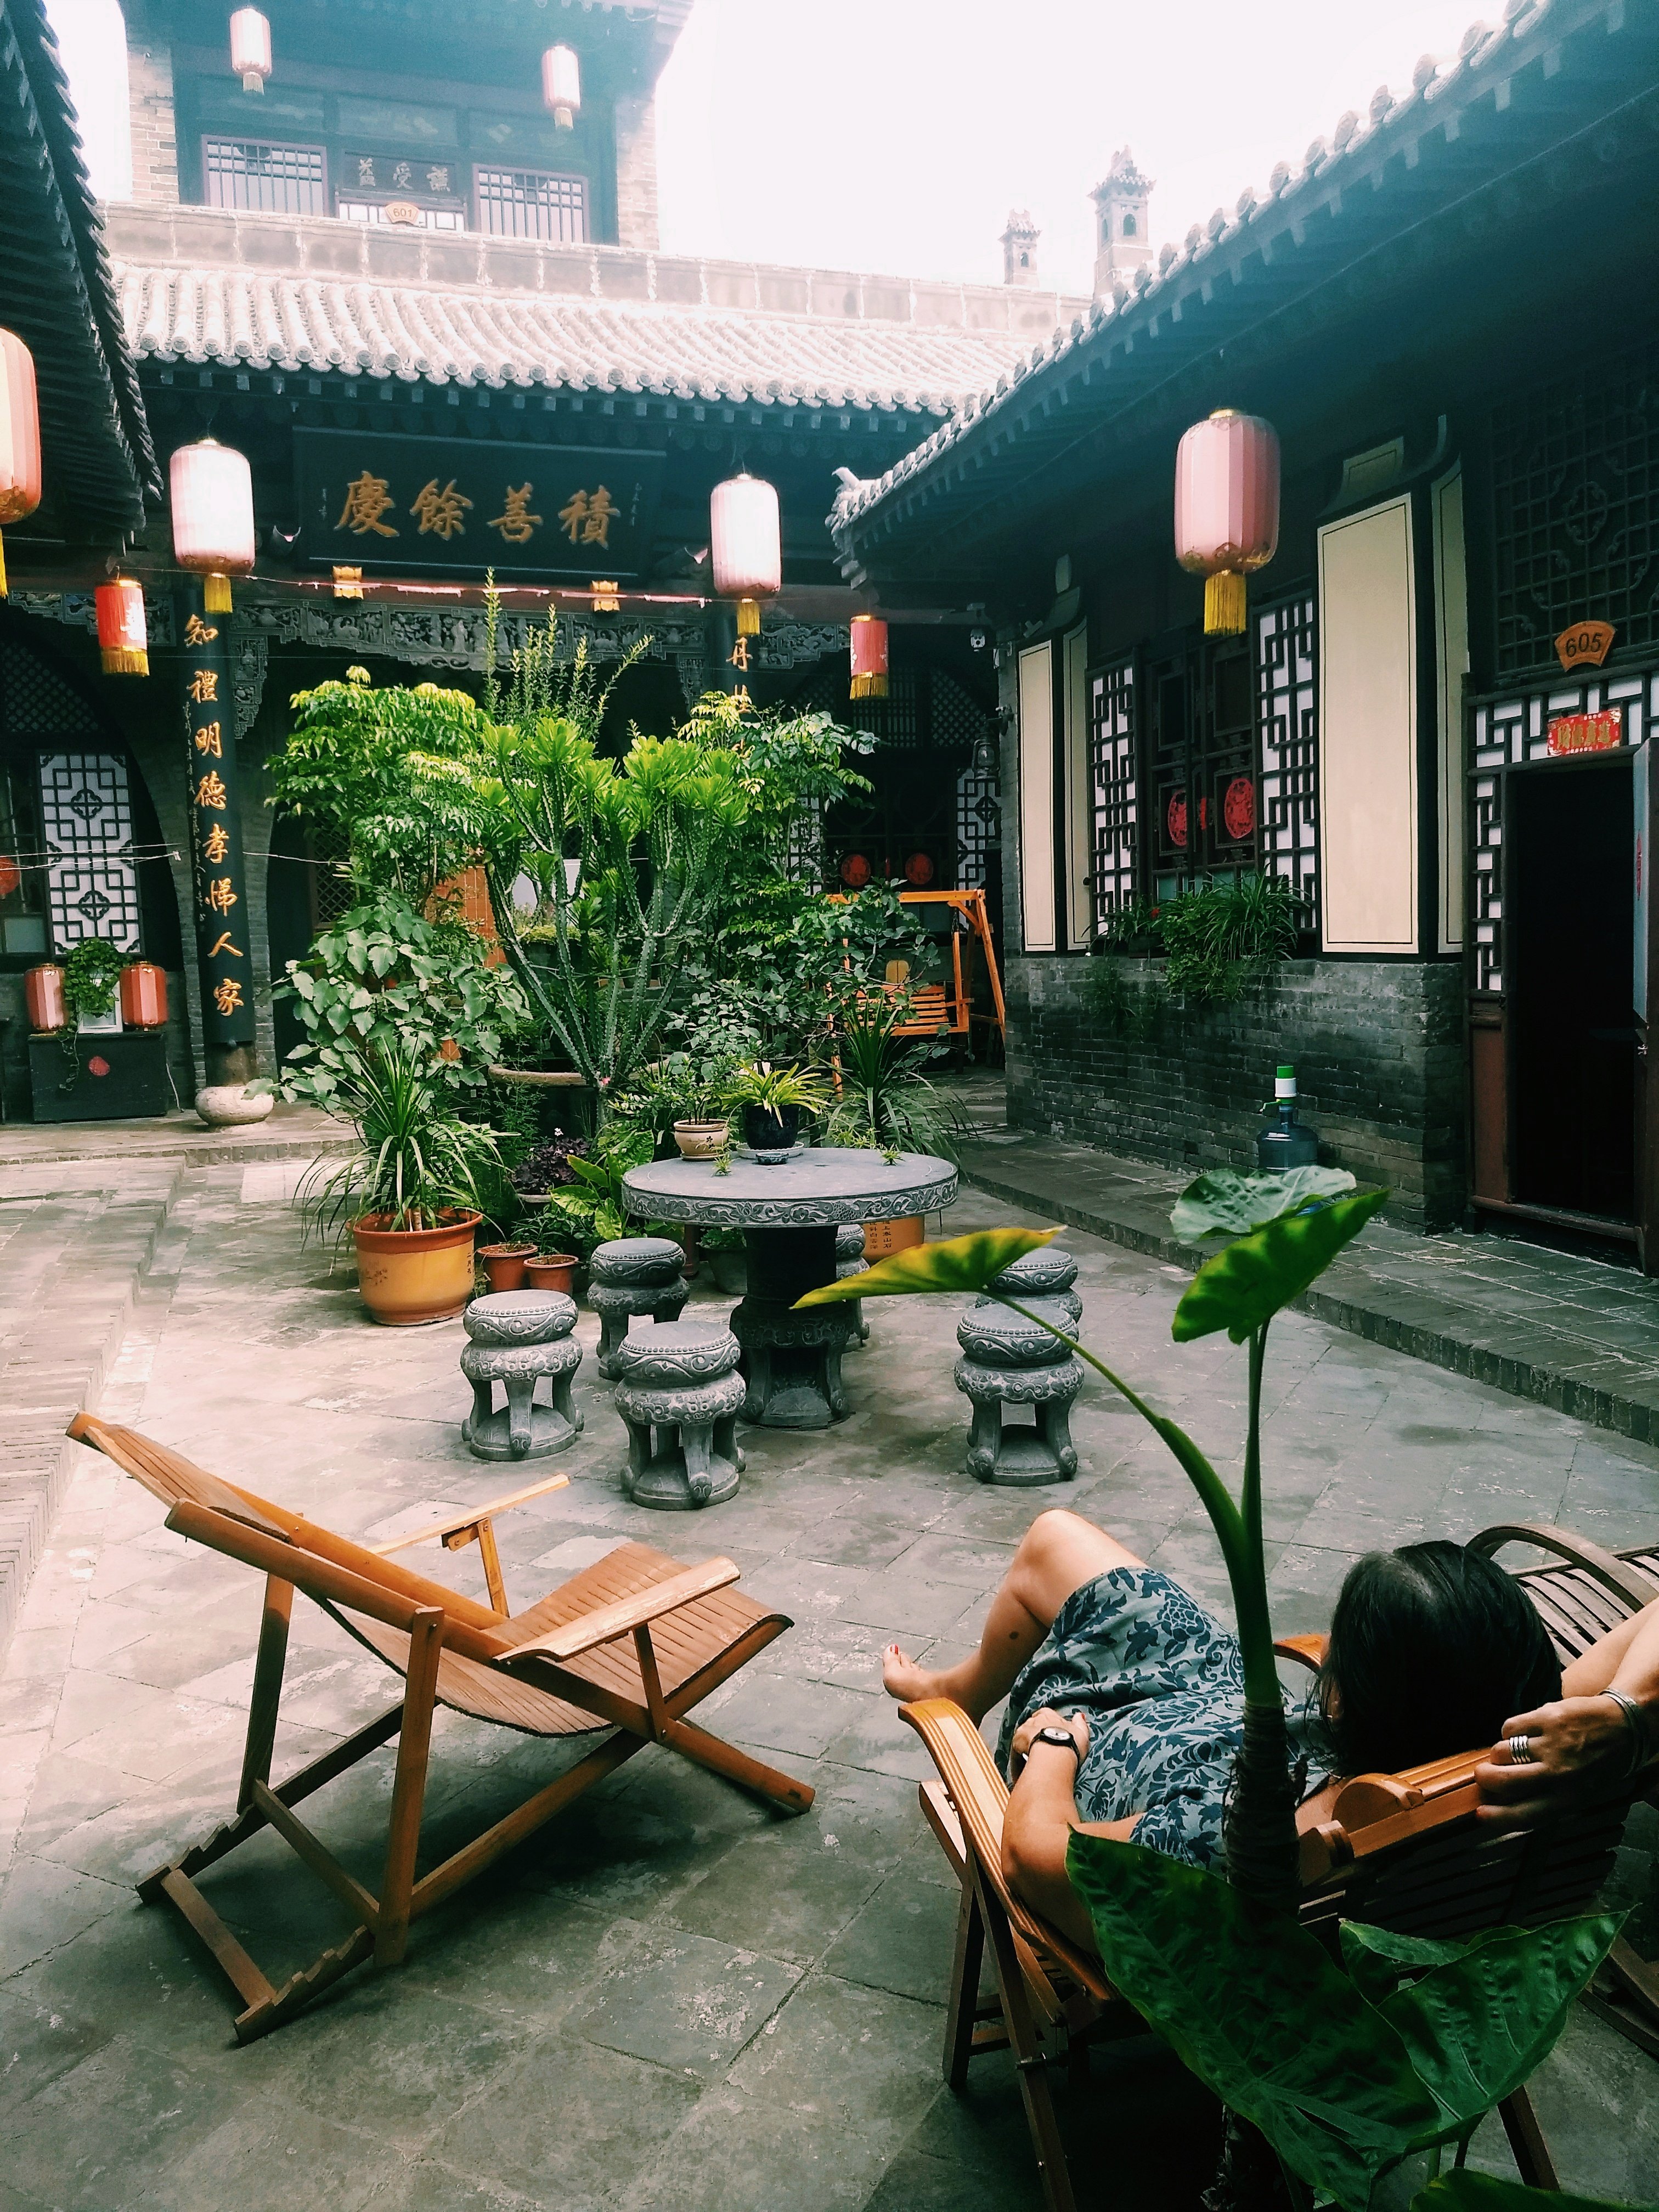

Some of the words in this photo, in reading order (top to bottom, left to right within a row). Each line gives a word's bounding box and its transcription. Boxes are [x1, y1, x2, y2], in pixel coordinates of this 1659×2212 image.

[393, 208, 412, 217] 601
[1565, 631, 1602, 658] 605
[184, 613, 245, 1017] 知禮明德孝悌人家
